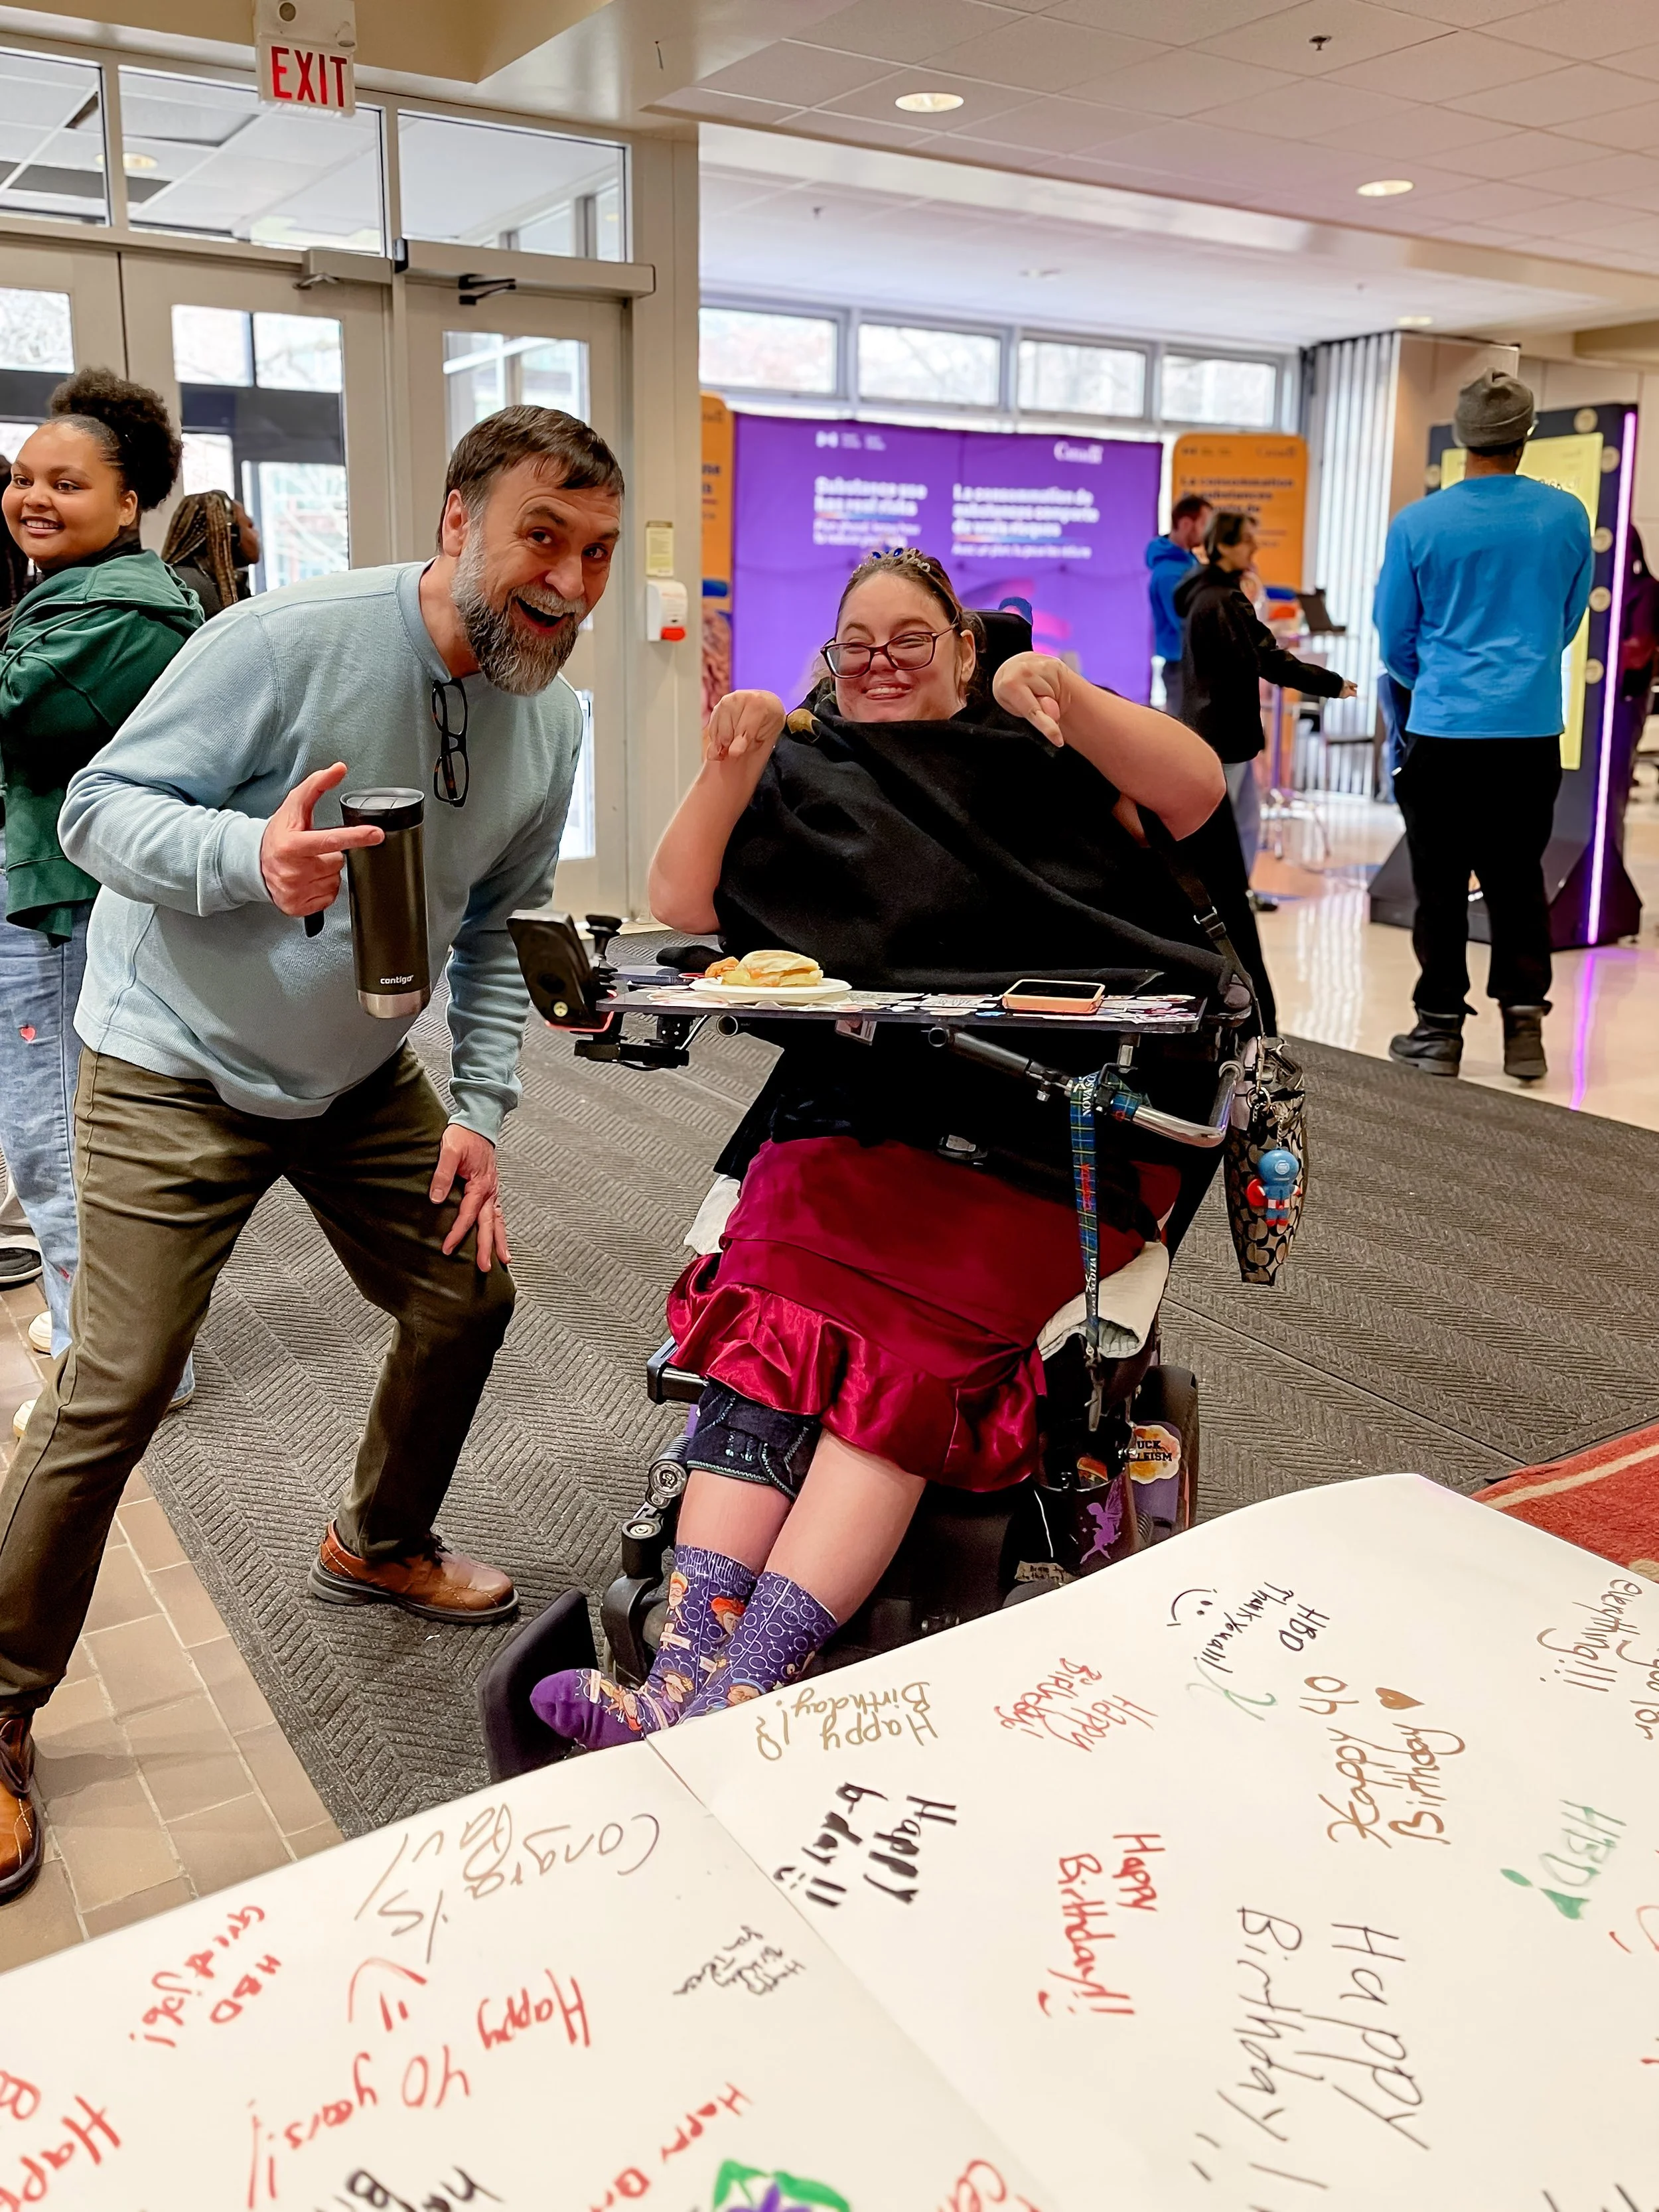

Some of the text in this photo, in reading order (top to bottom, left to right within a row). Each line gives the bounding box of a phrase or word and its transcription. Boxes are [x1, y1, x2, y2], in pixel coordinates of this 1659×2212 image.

[271, 46, 348, 108] EXIT
[380, 974, 414, 986] contigo
[1082, 1088, 1092, 1117] NOVA
[1136, 1440, 1161, 1449] UCK
[1279, 1603, 1330, 1651] HBD
[820, 1710, 938, 1751] Happy
[1043, 1694, 1159, 1753] Happy
[1299, 1676, 1408, 1849] Happy 40
[1384, 1723, 1465, 1848] Birthday
[863, 1795, 958, 1905] Happy
[1112, 1834, 1166, 1912] Happy
[210, 1954, 281, 2024] HBD
[476, 1968, 591, 2051] Happy
[1294, 1923, 1430, 2150] Happy
[401, 2044, 470, 2109] 40
[660, 2082, 753, 2164] Happy
